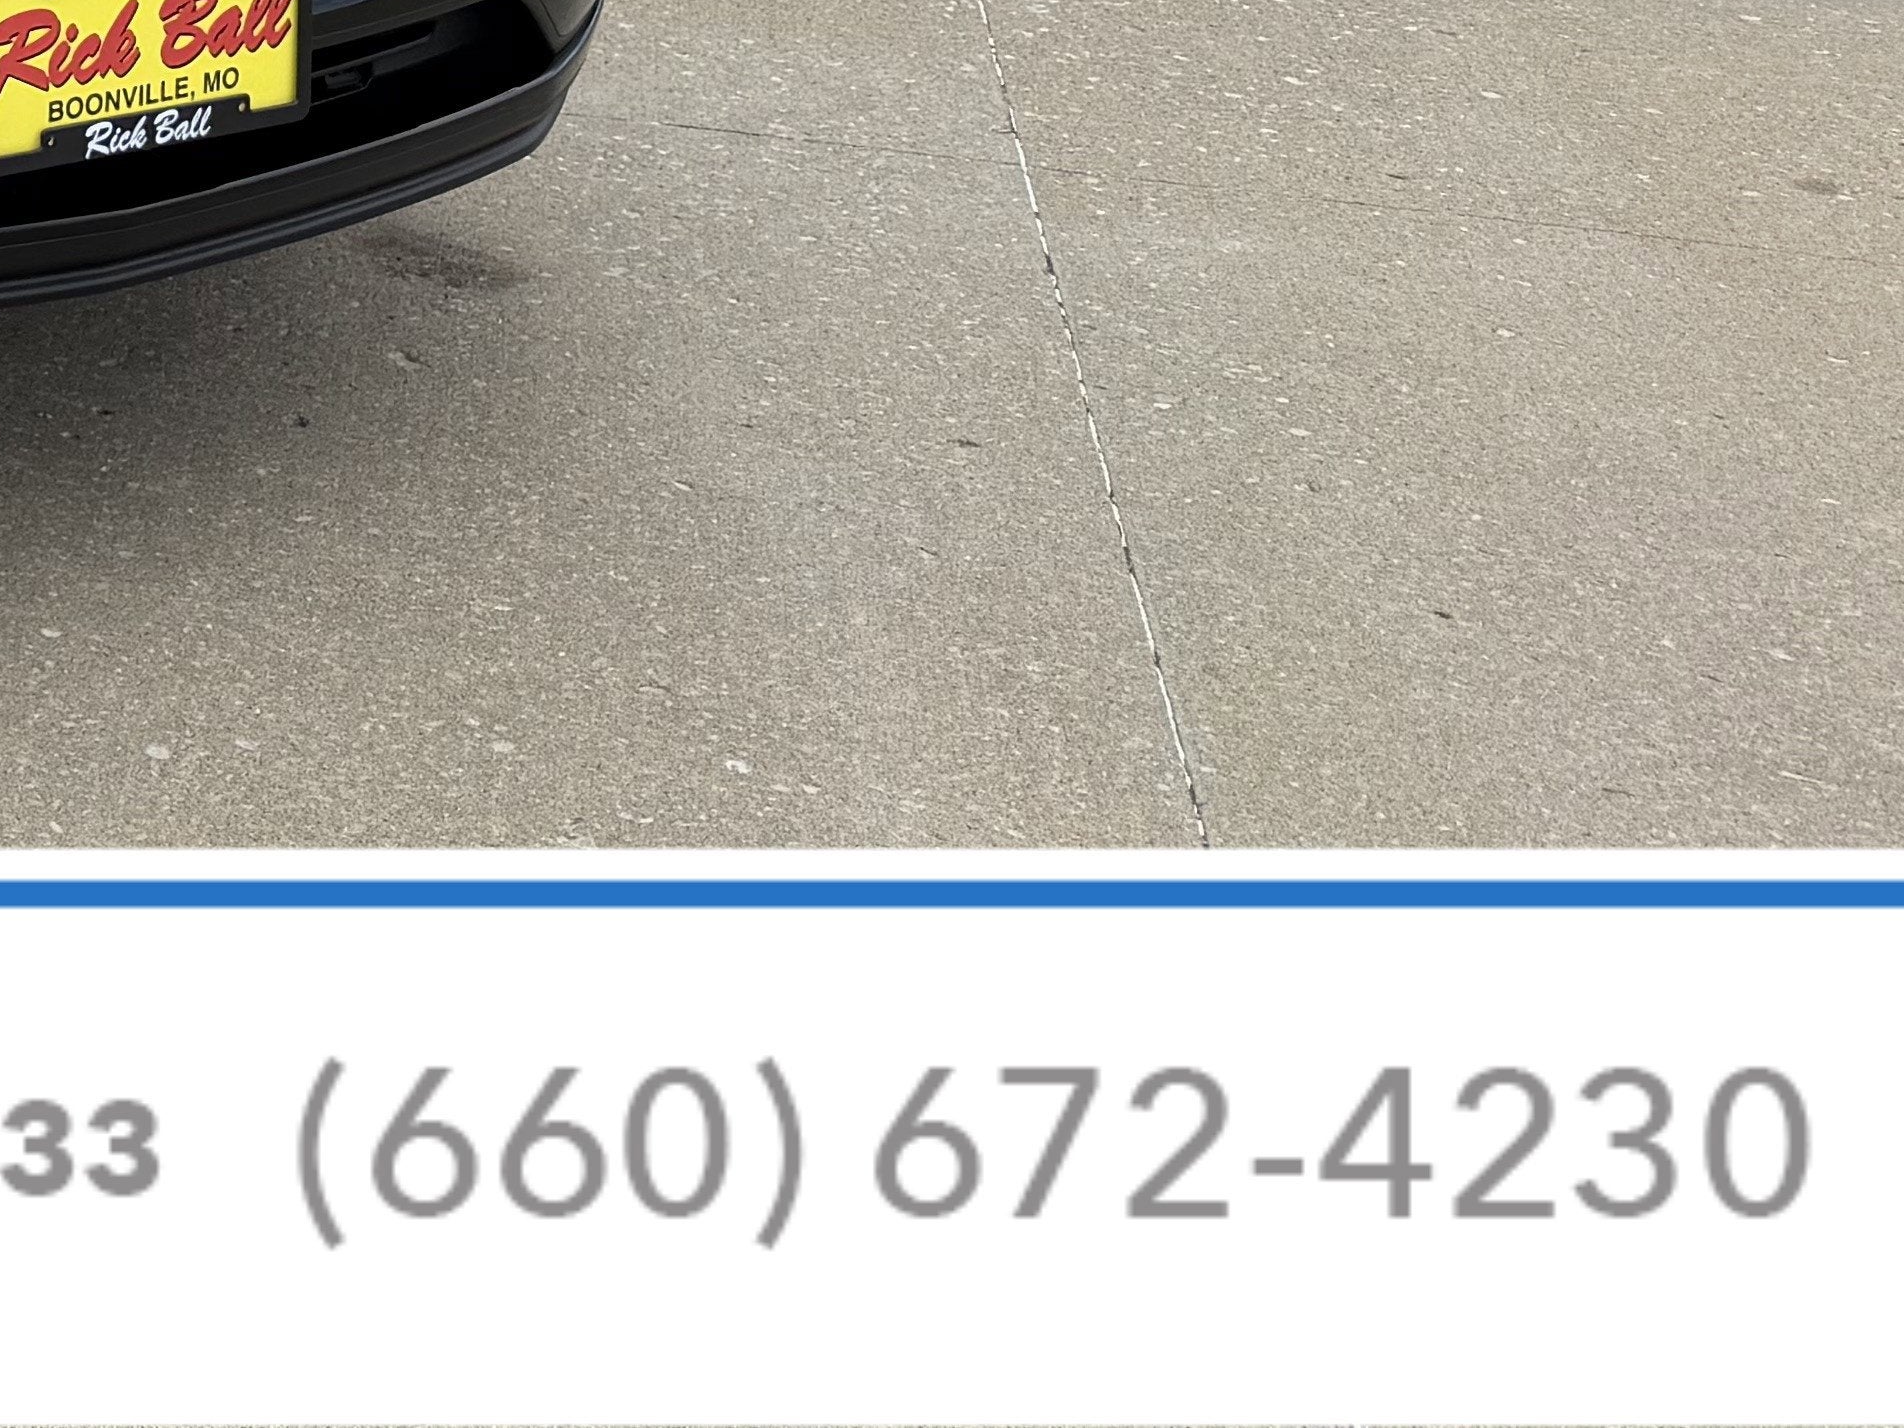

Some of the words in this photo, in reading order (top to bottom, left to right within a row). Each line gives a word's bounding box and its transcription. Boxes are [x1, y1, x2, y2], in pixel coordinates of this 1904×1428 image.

[48, 75, 195, 123] BOONVILLE,
[203, 67, 239, 94] MO
[85, 116, 147, 159] Rick
[154, 106, 212, 144] Ball
